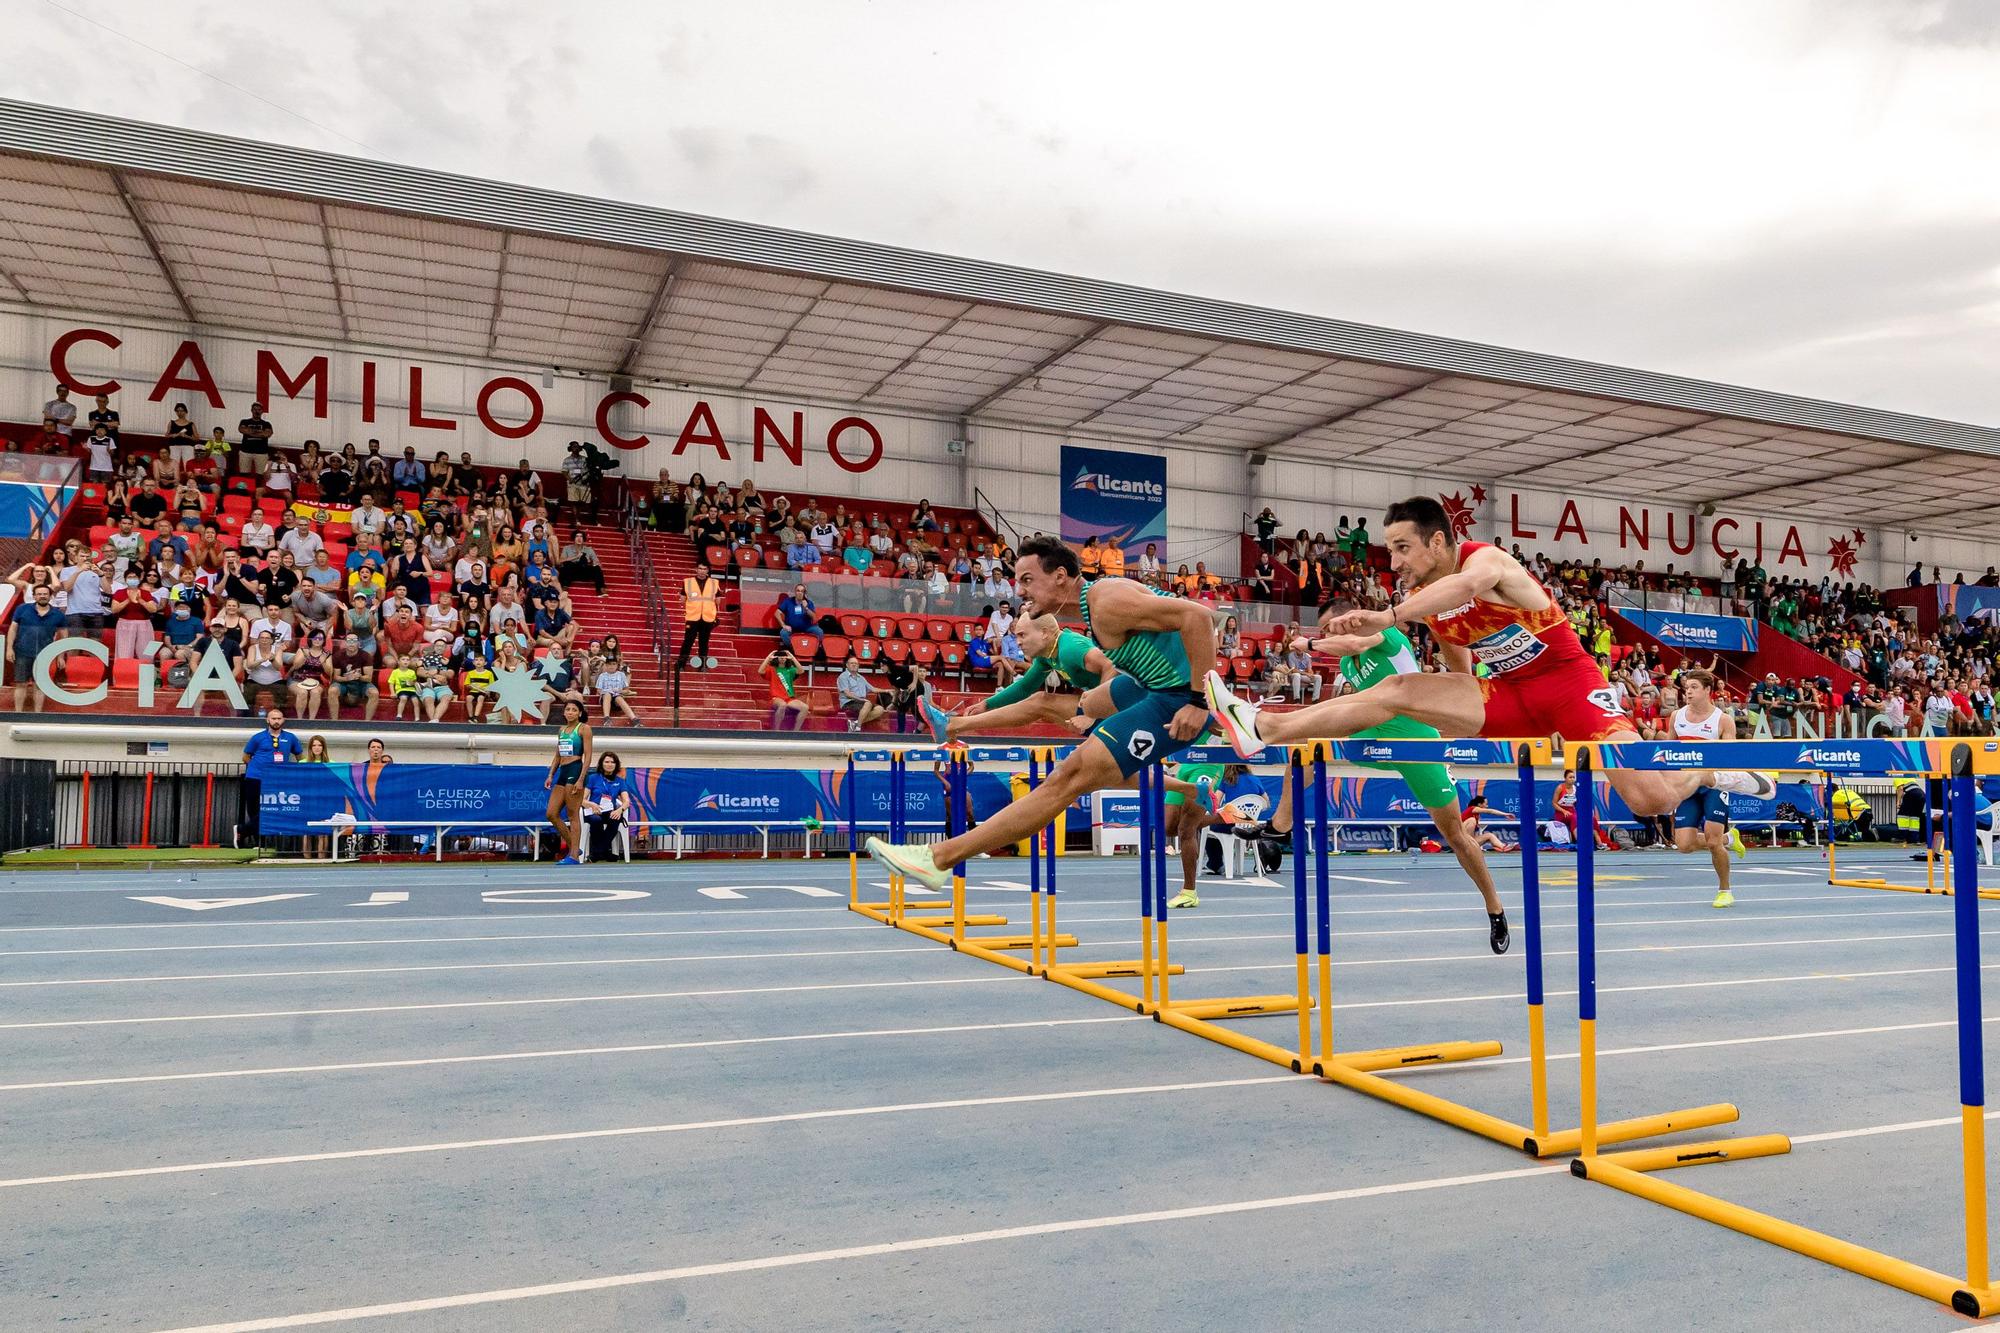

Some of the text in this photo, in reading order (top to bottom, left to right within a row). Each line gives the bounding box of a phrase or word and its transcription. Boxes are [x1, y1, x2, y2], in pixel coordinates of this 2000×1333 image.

[50, 328, 884, 473] CAMILO CANO
[1511, 493, 1808, 568] LA NUCIA
[1477, 632, 1531, 660] CISNEROS
[1494, 650, 1536, 672] Joma
[1133, 738, 1154, 757] 4
[417, 788, 491, 799] LA FUERZA
[425, 799, 484, 809] DESTINO
